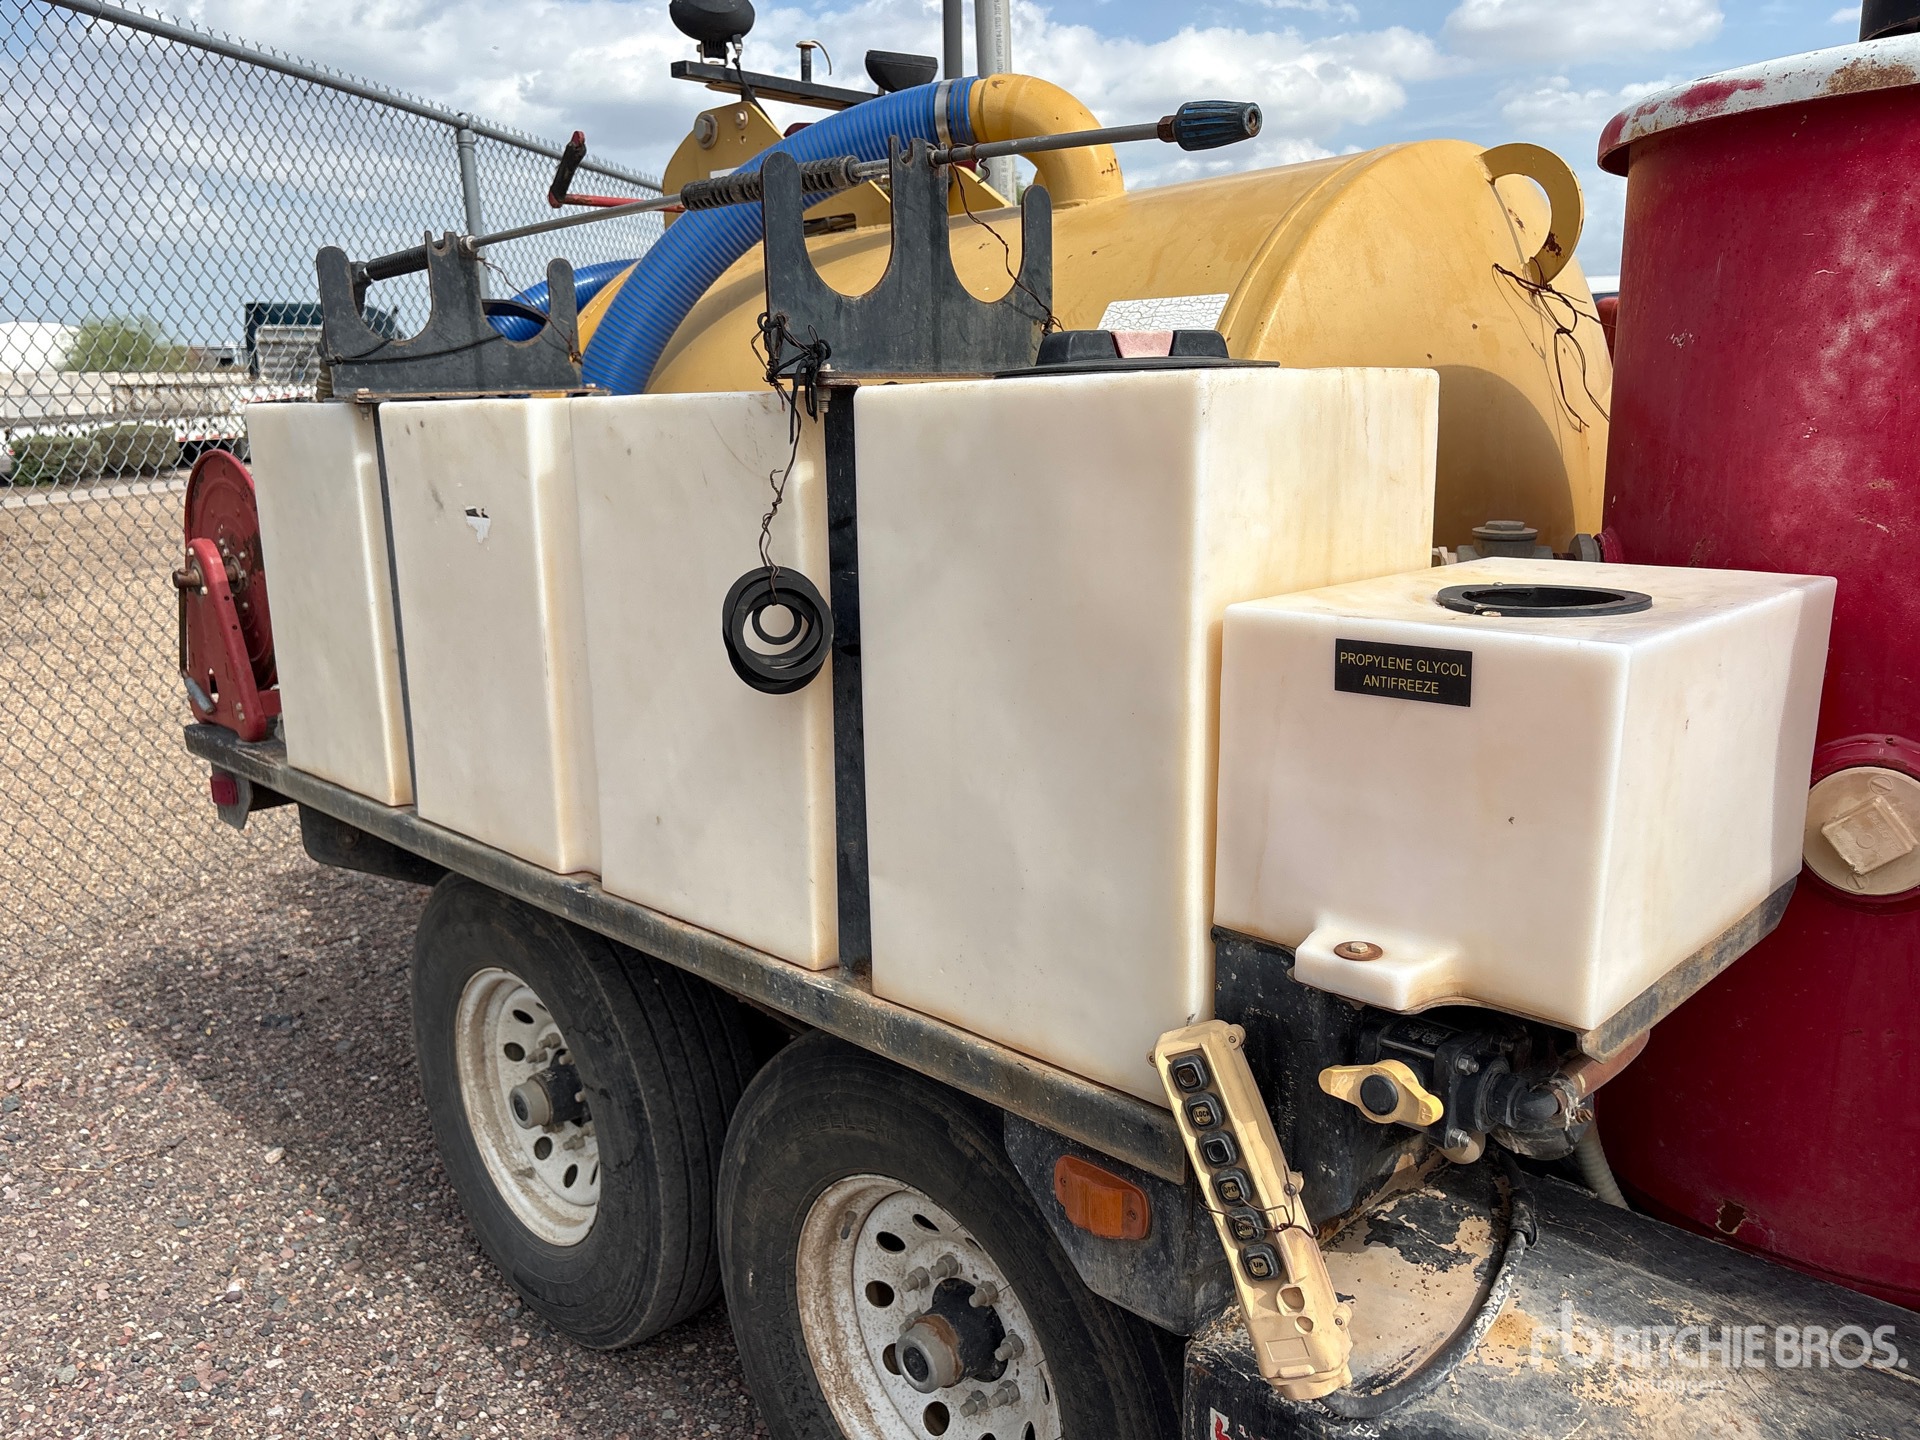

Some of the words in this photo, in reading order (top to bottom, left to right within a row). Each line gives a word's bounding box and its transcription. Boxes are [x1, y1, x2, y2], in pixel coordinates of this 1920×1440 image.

[1340, 651, 1413, 671] PROPYLENE
[1416, 660, 1467, 677] GLYCOL
[1363, 674, 1439, 694] ANTIFREEZE
[1253, 1261, 1264, 1269] UP
